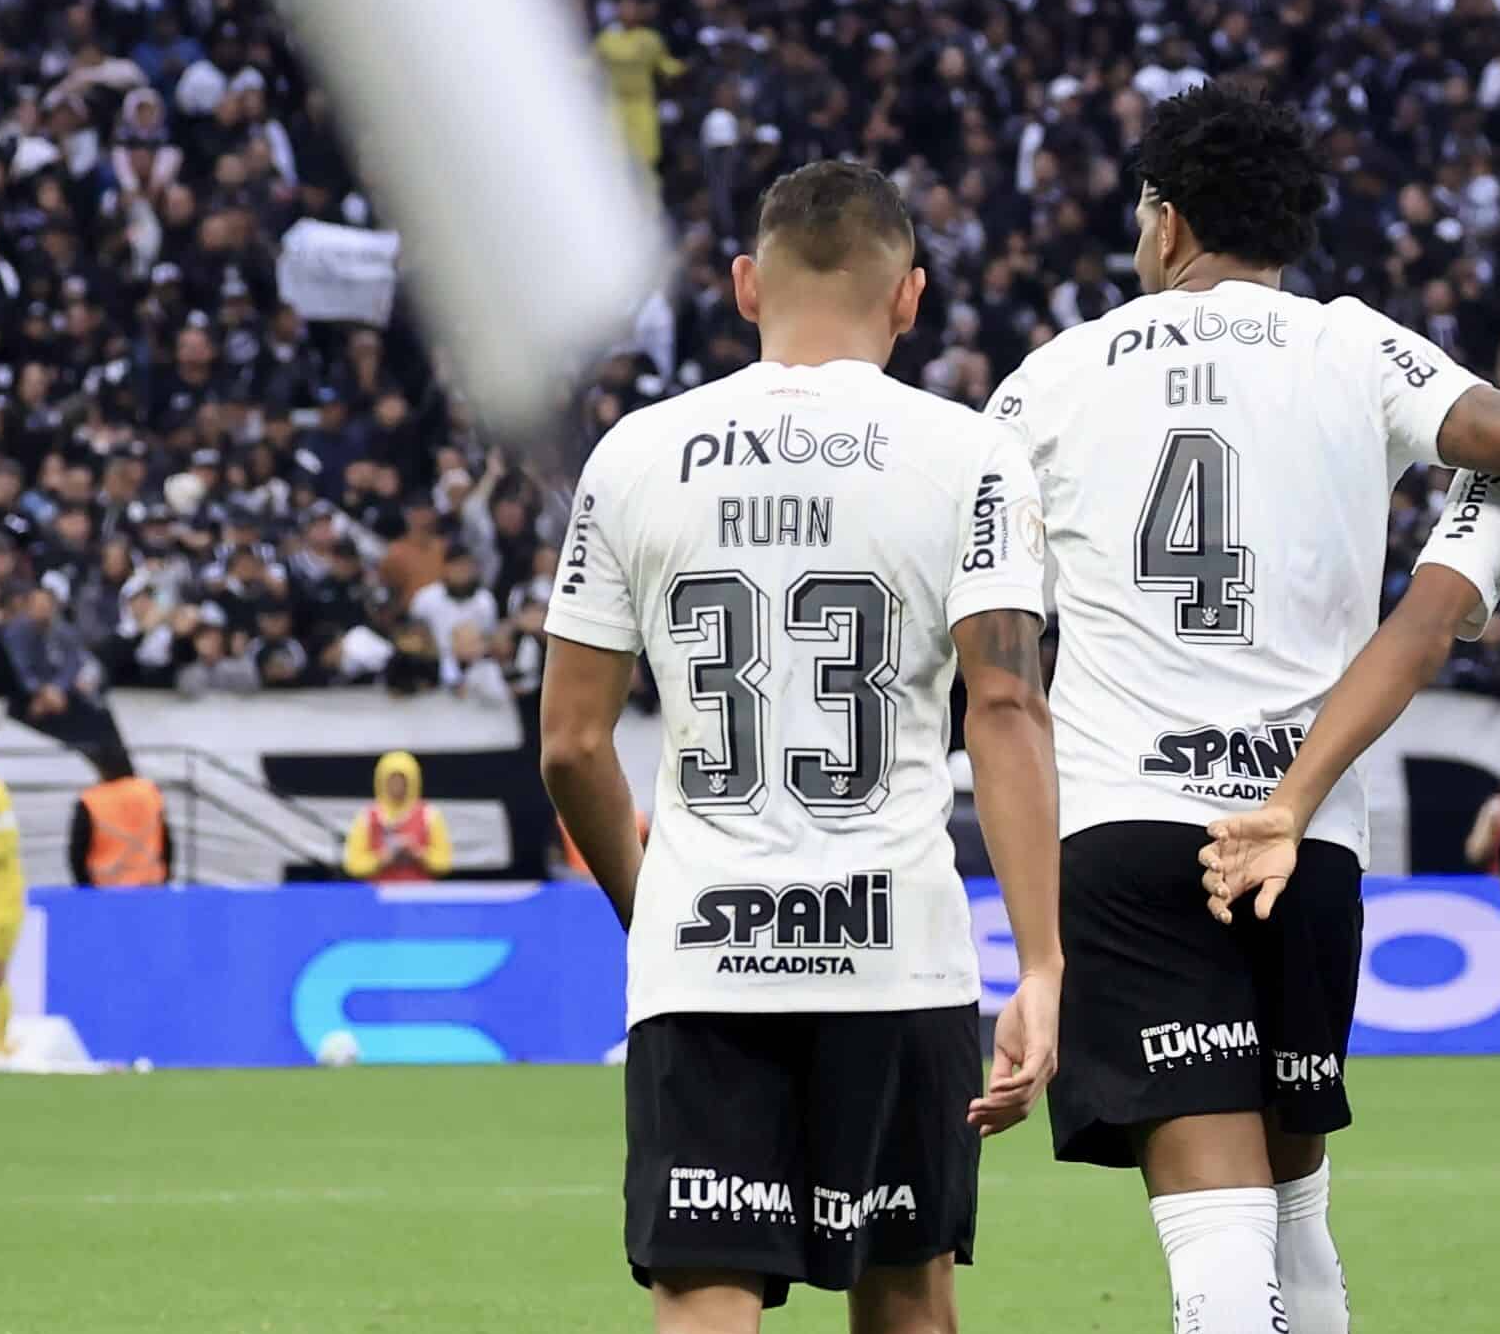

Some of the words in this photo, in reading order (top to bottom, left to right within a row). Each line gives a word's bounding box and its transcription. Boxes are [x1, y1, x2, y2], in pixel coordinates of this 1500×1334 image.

[1107, 305, 1291, 366] pixbet
[1166, 362, 1227, 407] GIL
[681, 414, 890, 483] pixbet
[718, 495, 833, 547] RUAN
[961, 496, 1005, 573] bmg
[1133, 427, 1255, 646] 4
[665, 569, 902, 818] 33
[716, 955, 856, 975] ATACADISTA
[1140, 1021, 1181, 1038] GRUPO
[669, 1167, 717, 1180] GRUPO
[814, 1185, 850, 1203] GRUPO
